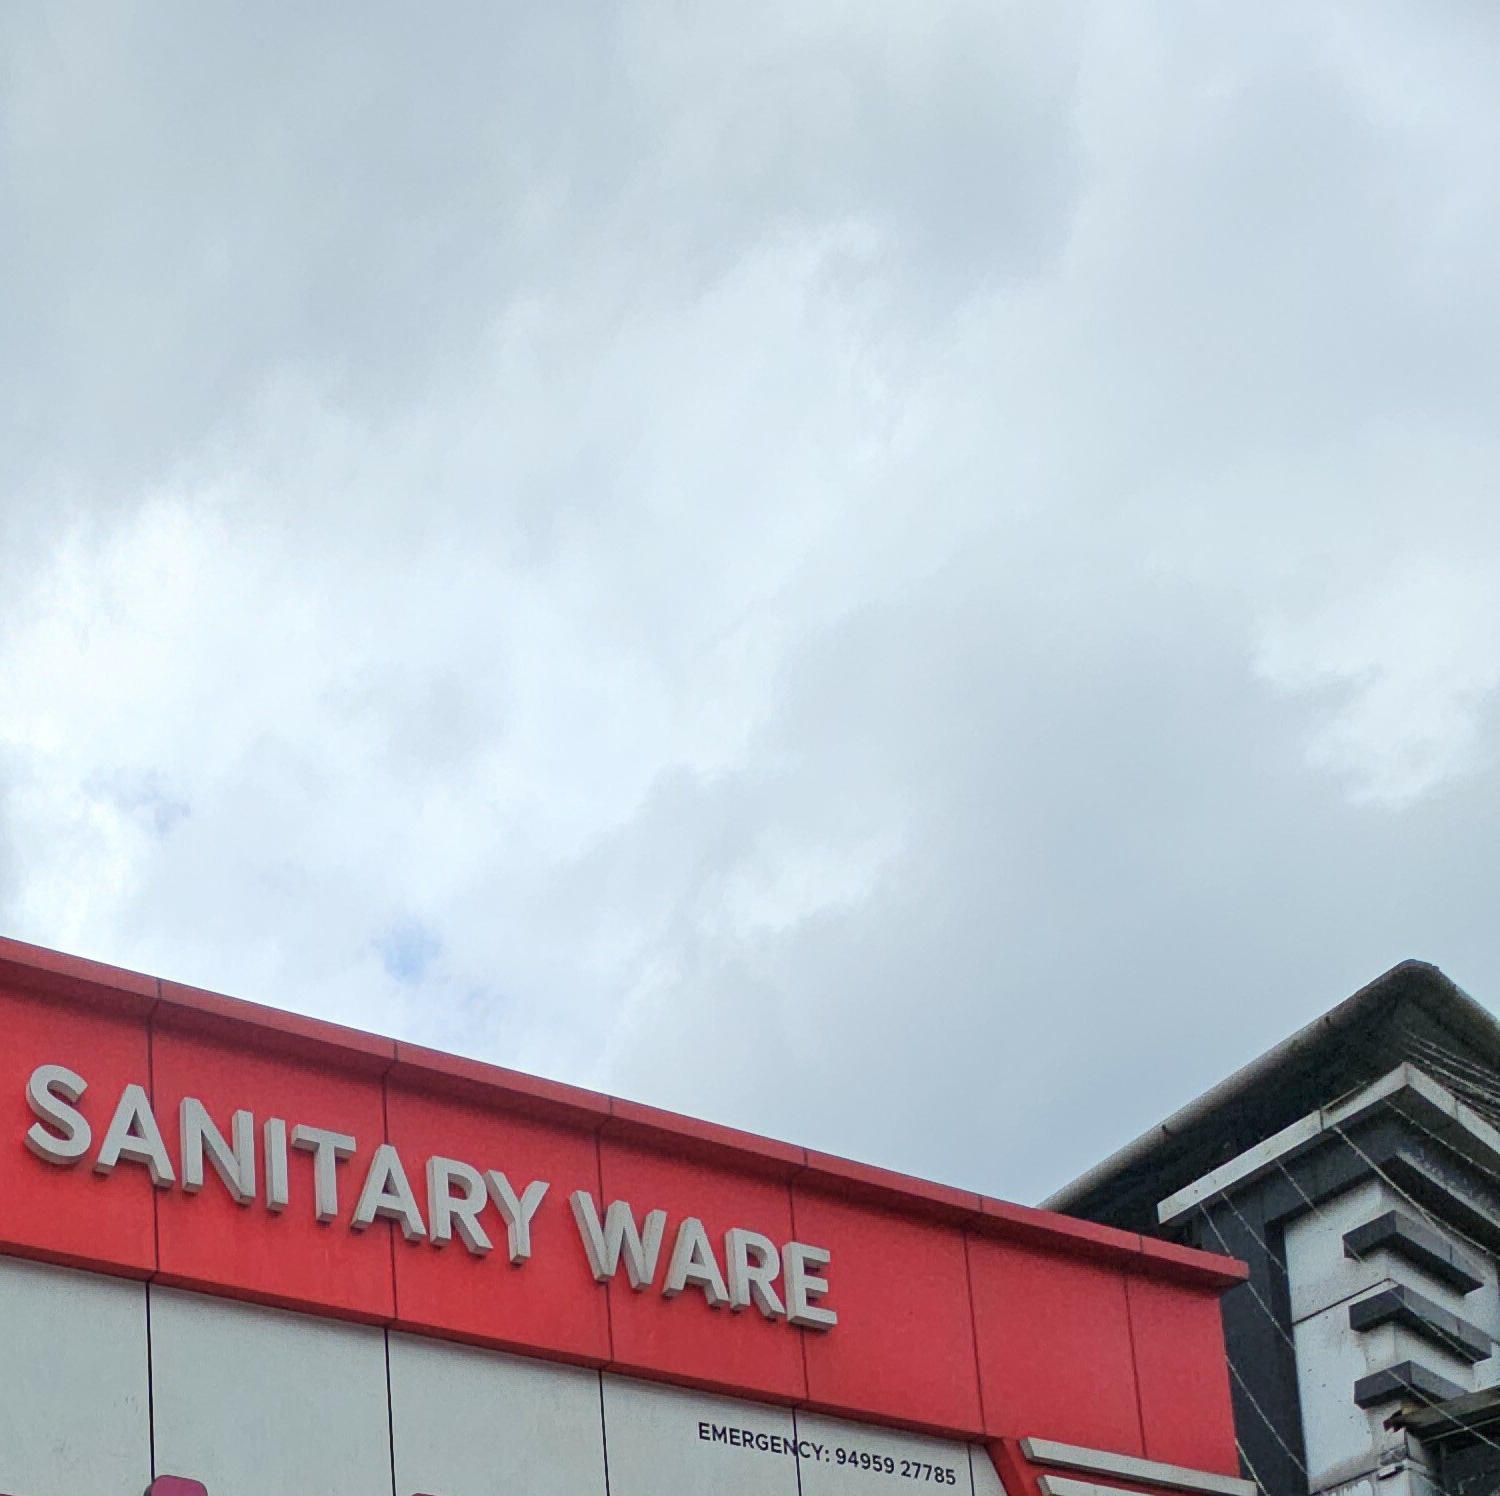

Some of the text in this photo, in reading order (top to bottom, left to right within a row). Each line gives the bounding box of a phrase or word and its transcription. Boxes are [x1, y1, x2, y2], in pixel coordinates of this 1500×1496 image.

[25, 1065, 550, 1265] SANITARY
[568, 1190, 838, 1331] WARE
[698, 1421, 956, 1486] EMERGENCY: 94959 27785
